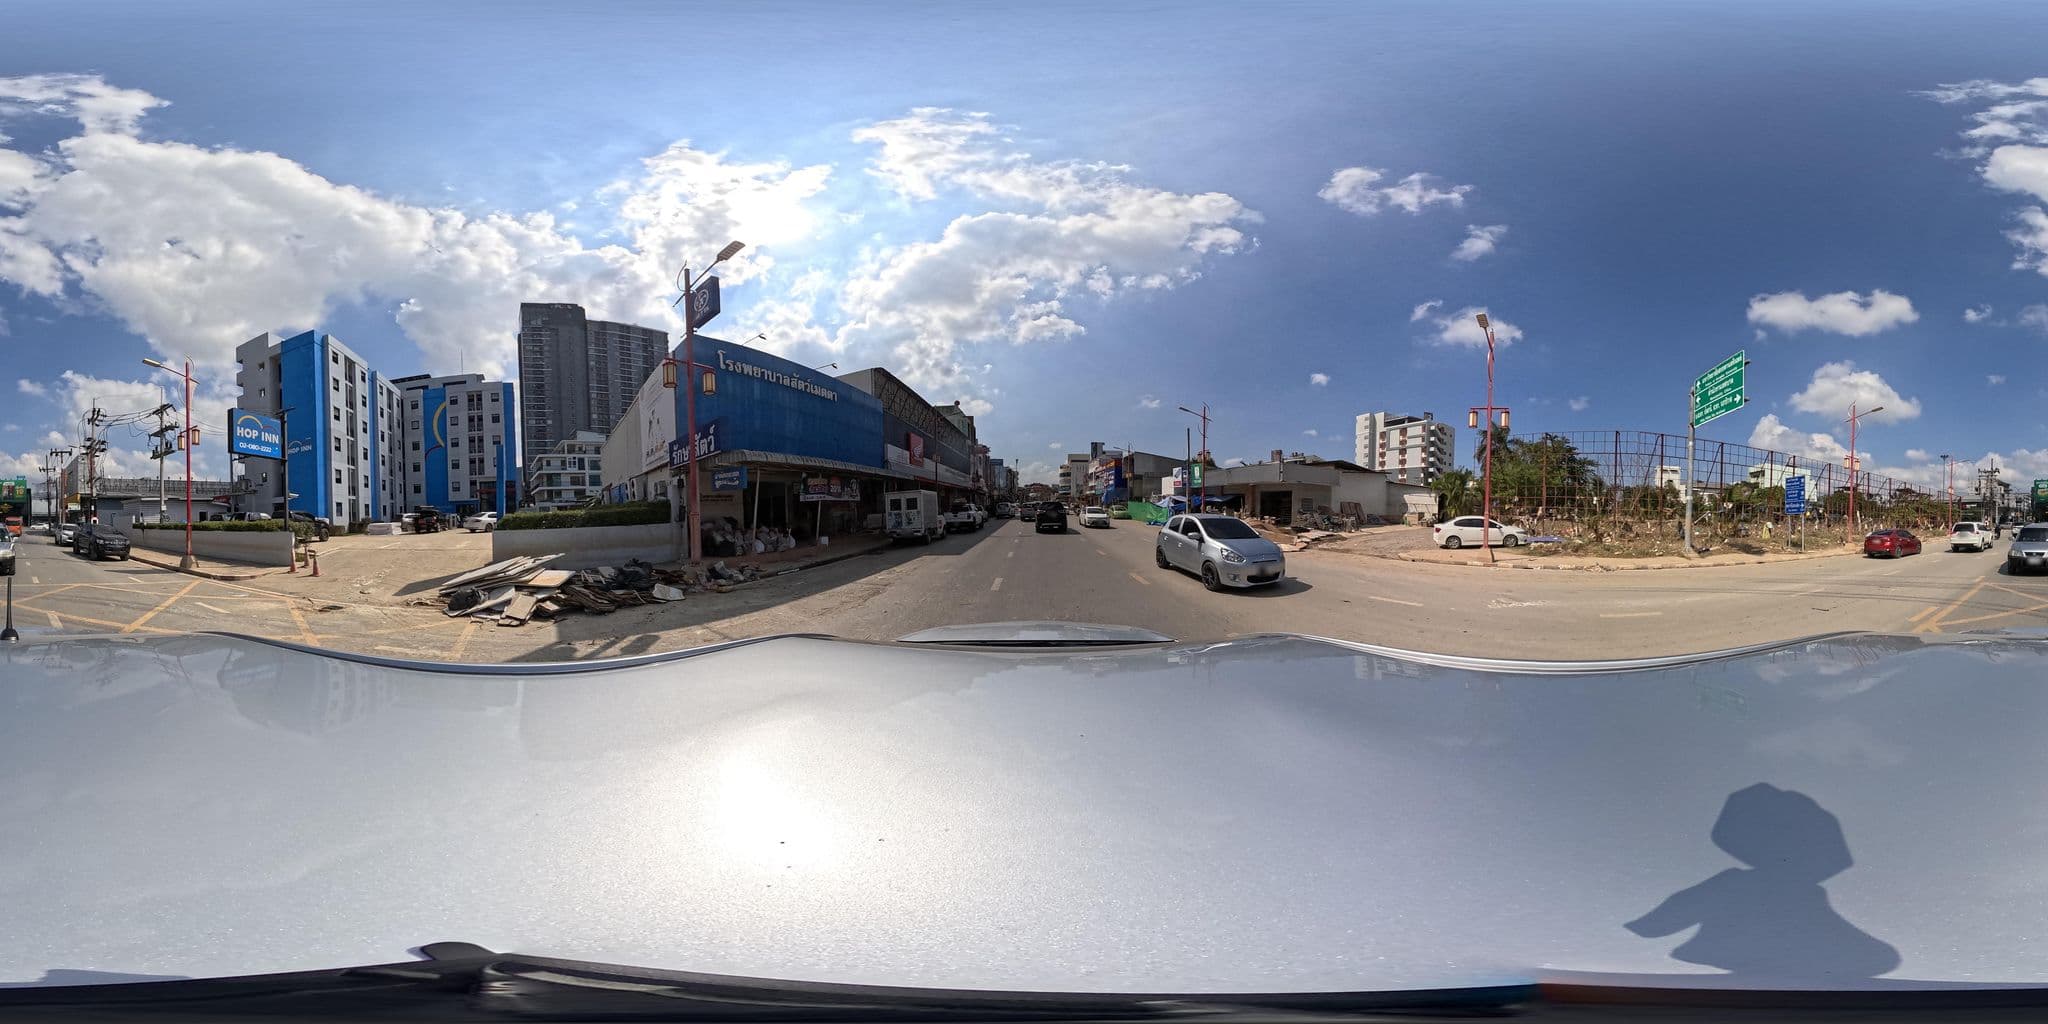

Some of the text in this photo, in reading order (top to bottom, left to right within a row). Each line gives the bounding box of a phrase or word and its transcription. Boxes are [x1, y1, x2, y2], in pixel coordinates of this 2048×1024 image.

[236, 426, 279, 444] HOP INN
[672, 424, 716, 465] รักษสัตว์
